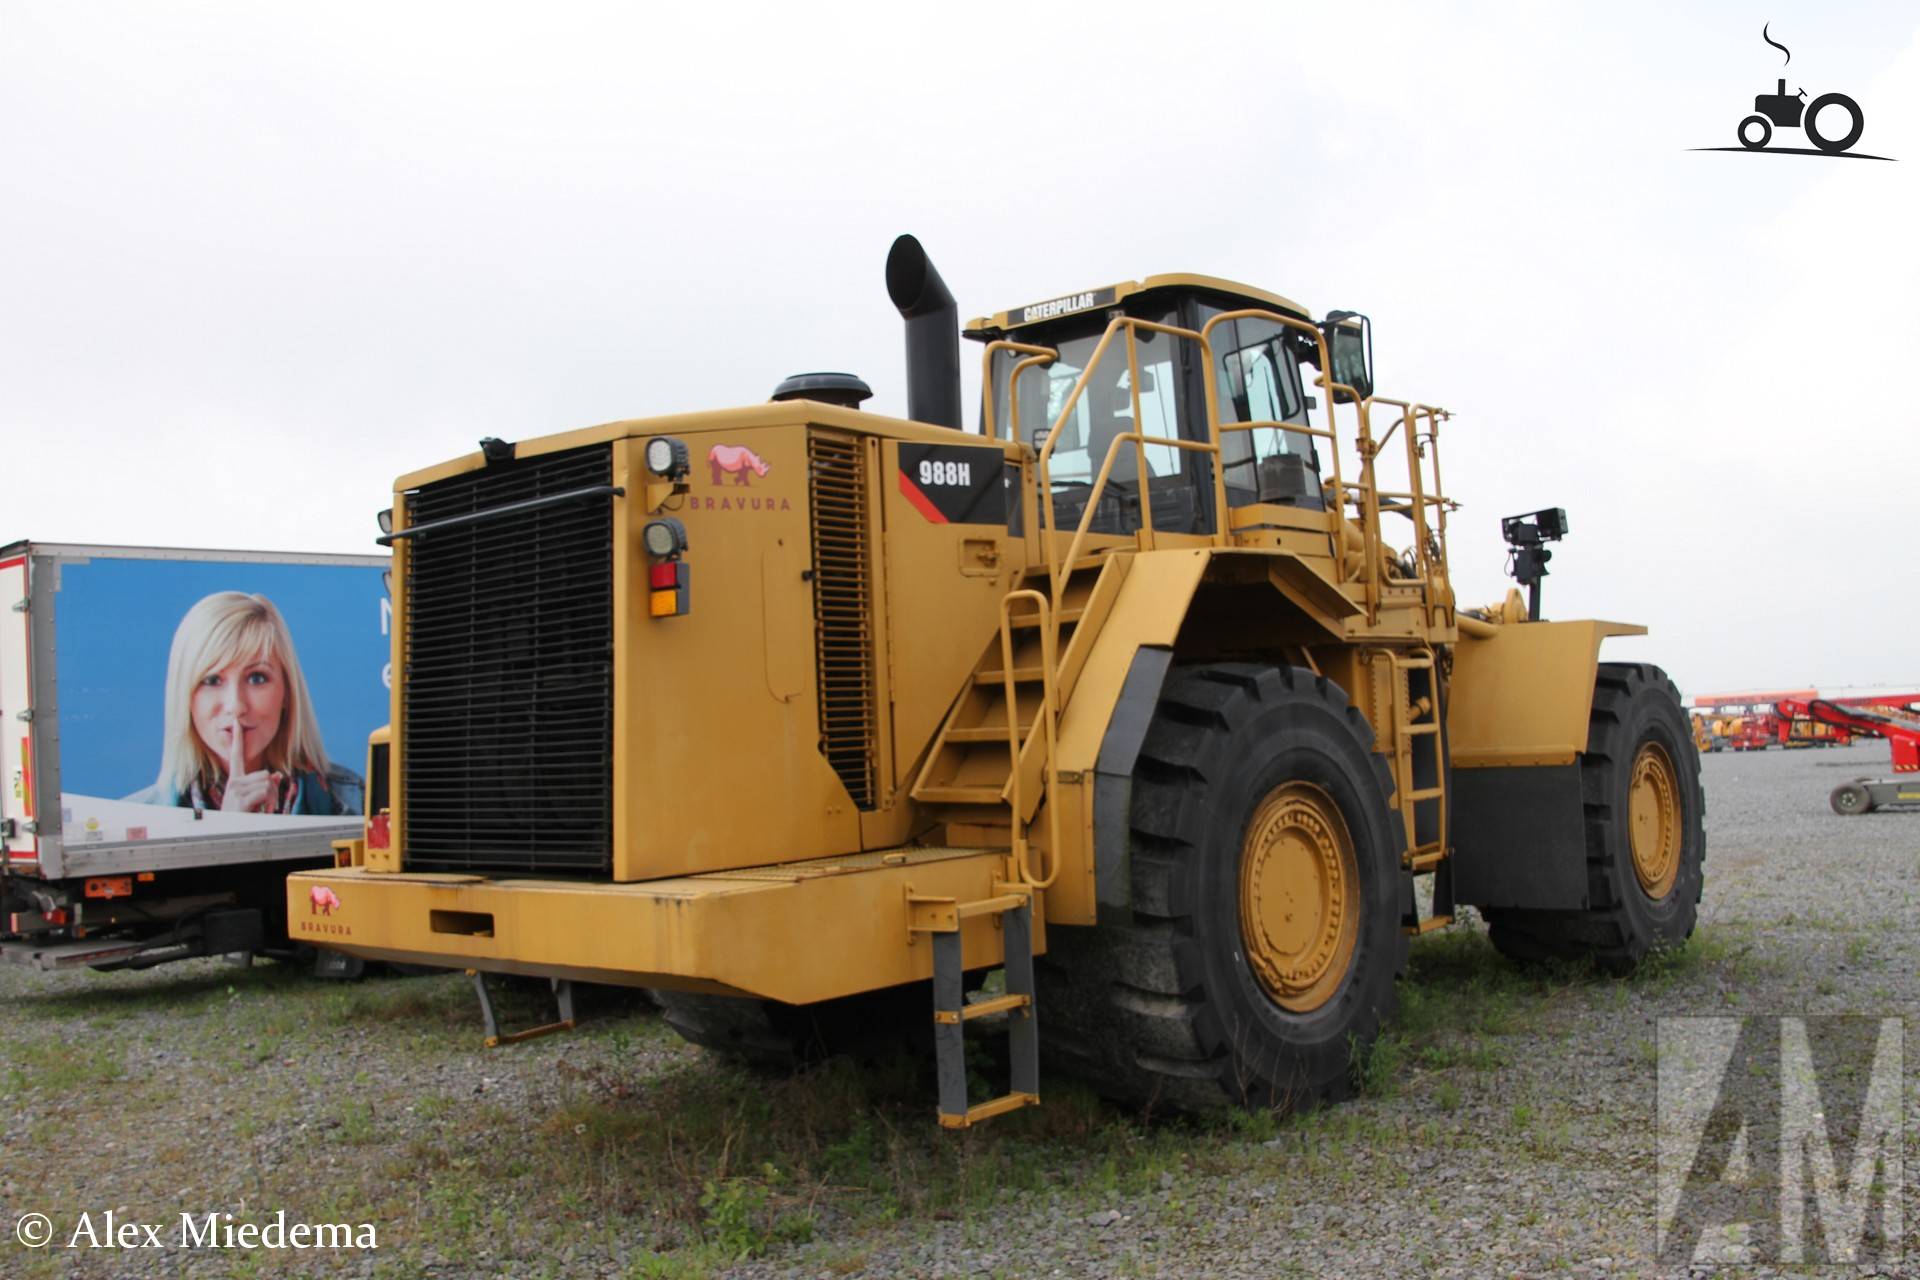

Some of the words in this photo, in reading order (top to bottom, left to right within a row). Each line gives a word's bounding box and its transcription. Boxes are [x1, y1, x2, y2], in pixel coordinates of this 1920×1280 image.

[1023, 292, 1094, 322] CATERPILLAR
[919, 460, 971, 486] 988H
[690, 496, 790, 511] BRAVURA
[301, 921, 352, 936] BRAVURA
